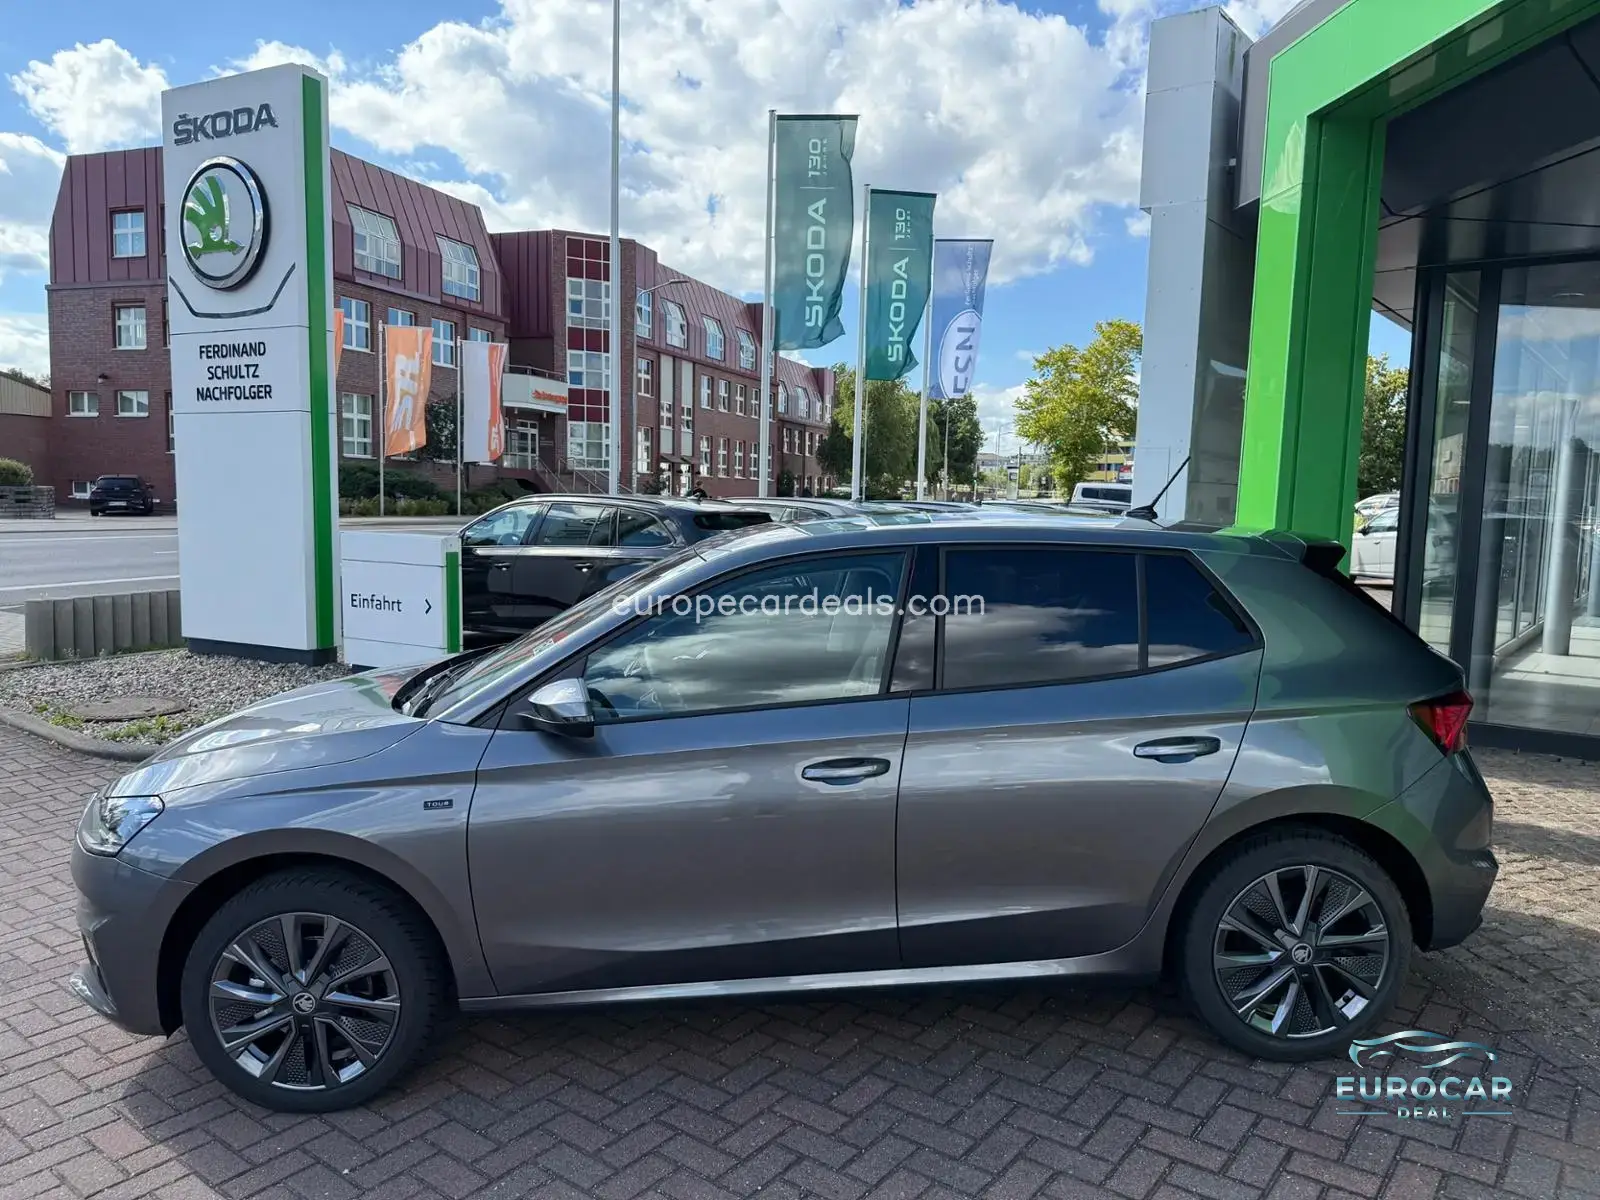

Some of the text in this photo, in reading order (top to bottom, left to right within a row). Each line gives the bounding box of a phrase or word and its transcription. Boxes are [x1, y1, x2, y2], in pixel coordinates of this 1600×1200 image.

[173, 102, 279, 146] ŠKODA
[808, 138, 821, 178] 130
[895, 207, 905, 241] 130
[199, 341, 267, 360] FERDINAND
[206, 363, 260, 381] SCHULTZ
[196, 384, 273, 402] NACHFOLGER
[350, 593, 403, 613] Einfahrt
